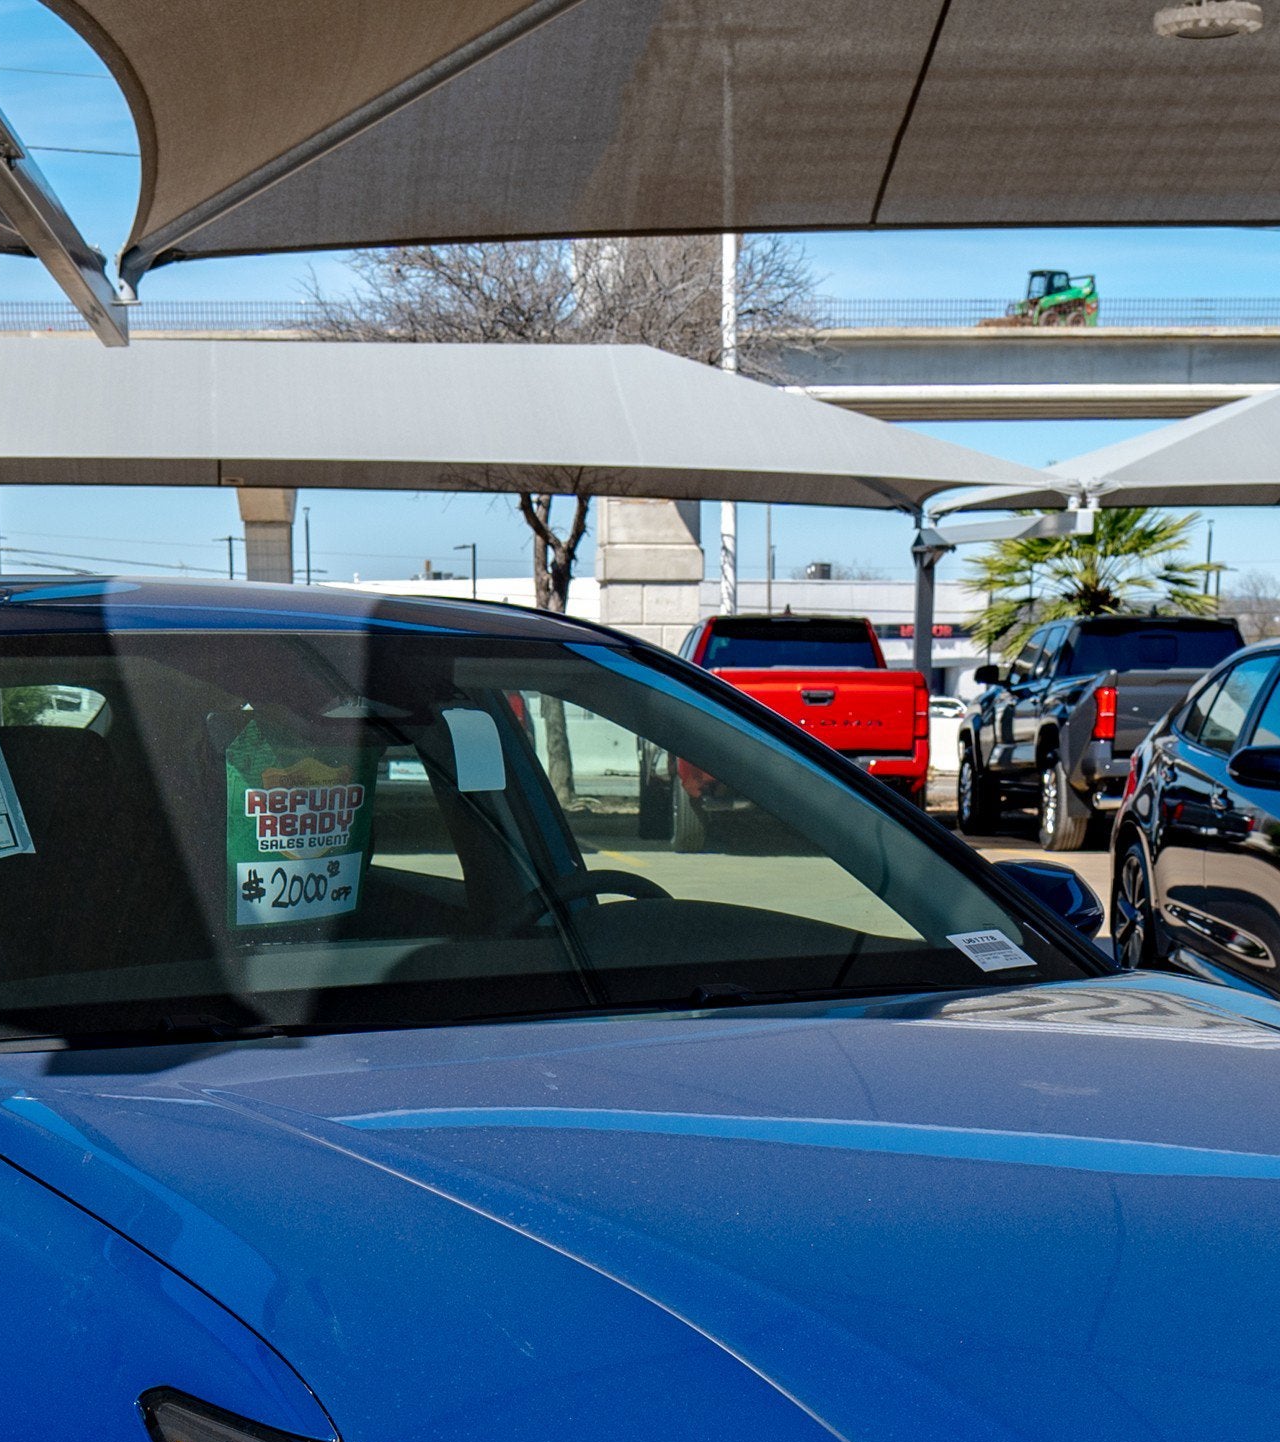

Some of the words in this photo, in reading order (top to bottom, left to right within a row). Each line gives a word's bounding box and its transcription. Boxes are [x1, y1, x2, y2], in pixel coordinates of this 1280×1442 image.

[247, 785, 364, 815] REFUND
[258, 809, 354, 838] READY
[260, 837, 305, 851] SALES
[308, 833, 350, 848] EVENT
[330, 886, 352, 902] OFF
